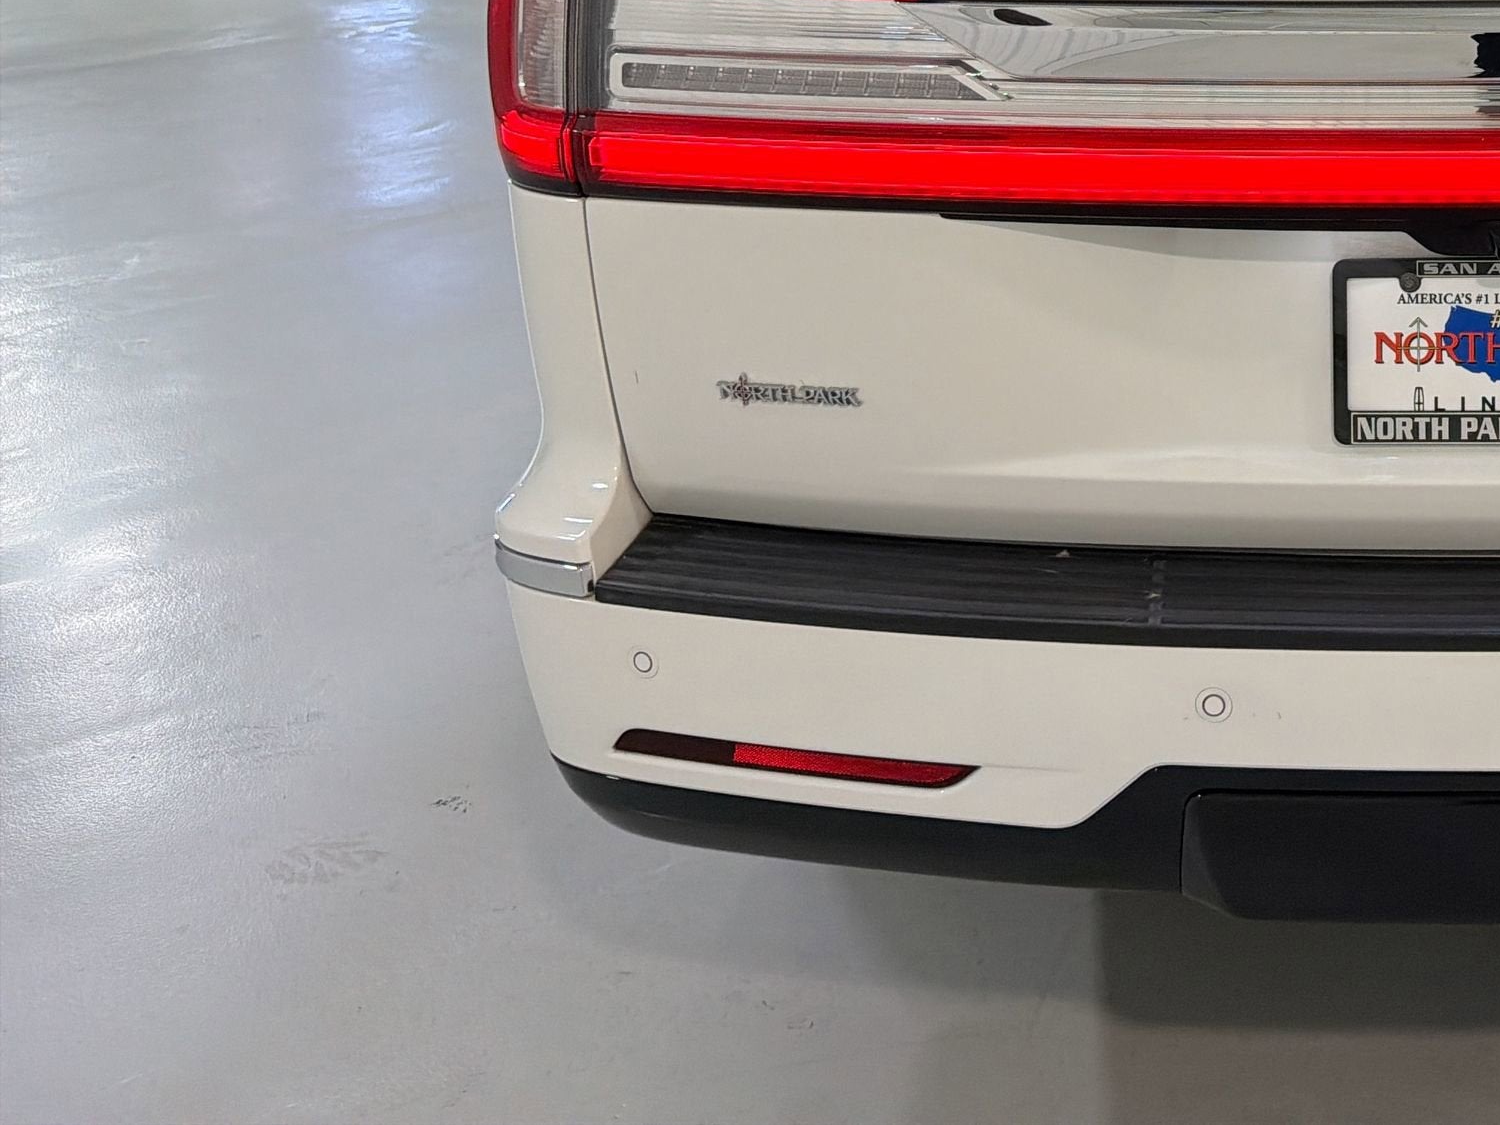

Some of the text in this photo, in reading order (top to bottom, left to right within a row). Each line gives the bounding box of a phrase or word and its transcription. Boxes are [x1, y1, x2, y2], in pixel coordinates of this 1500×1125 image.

[1423, 262, 1477, 275] SAN
[1397, 292, 1471, 305] AMERICA'S
[1475, 292, 1490, 305] #1
[717, 380, 863, 407] NORTH PARK
[1356, 416, 1450, 441] NORTH
